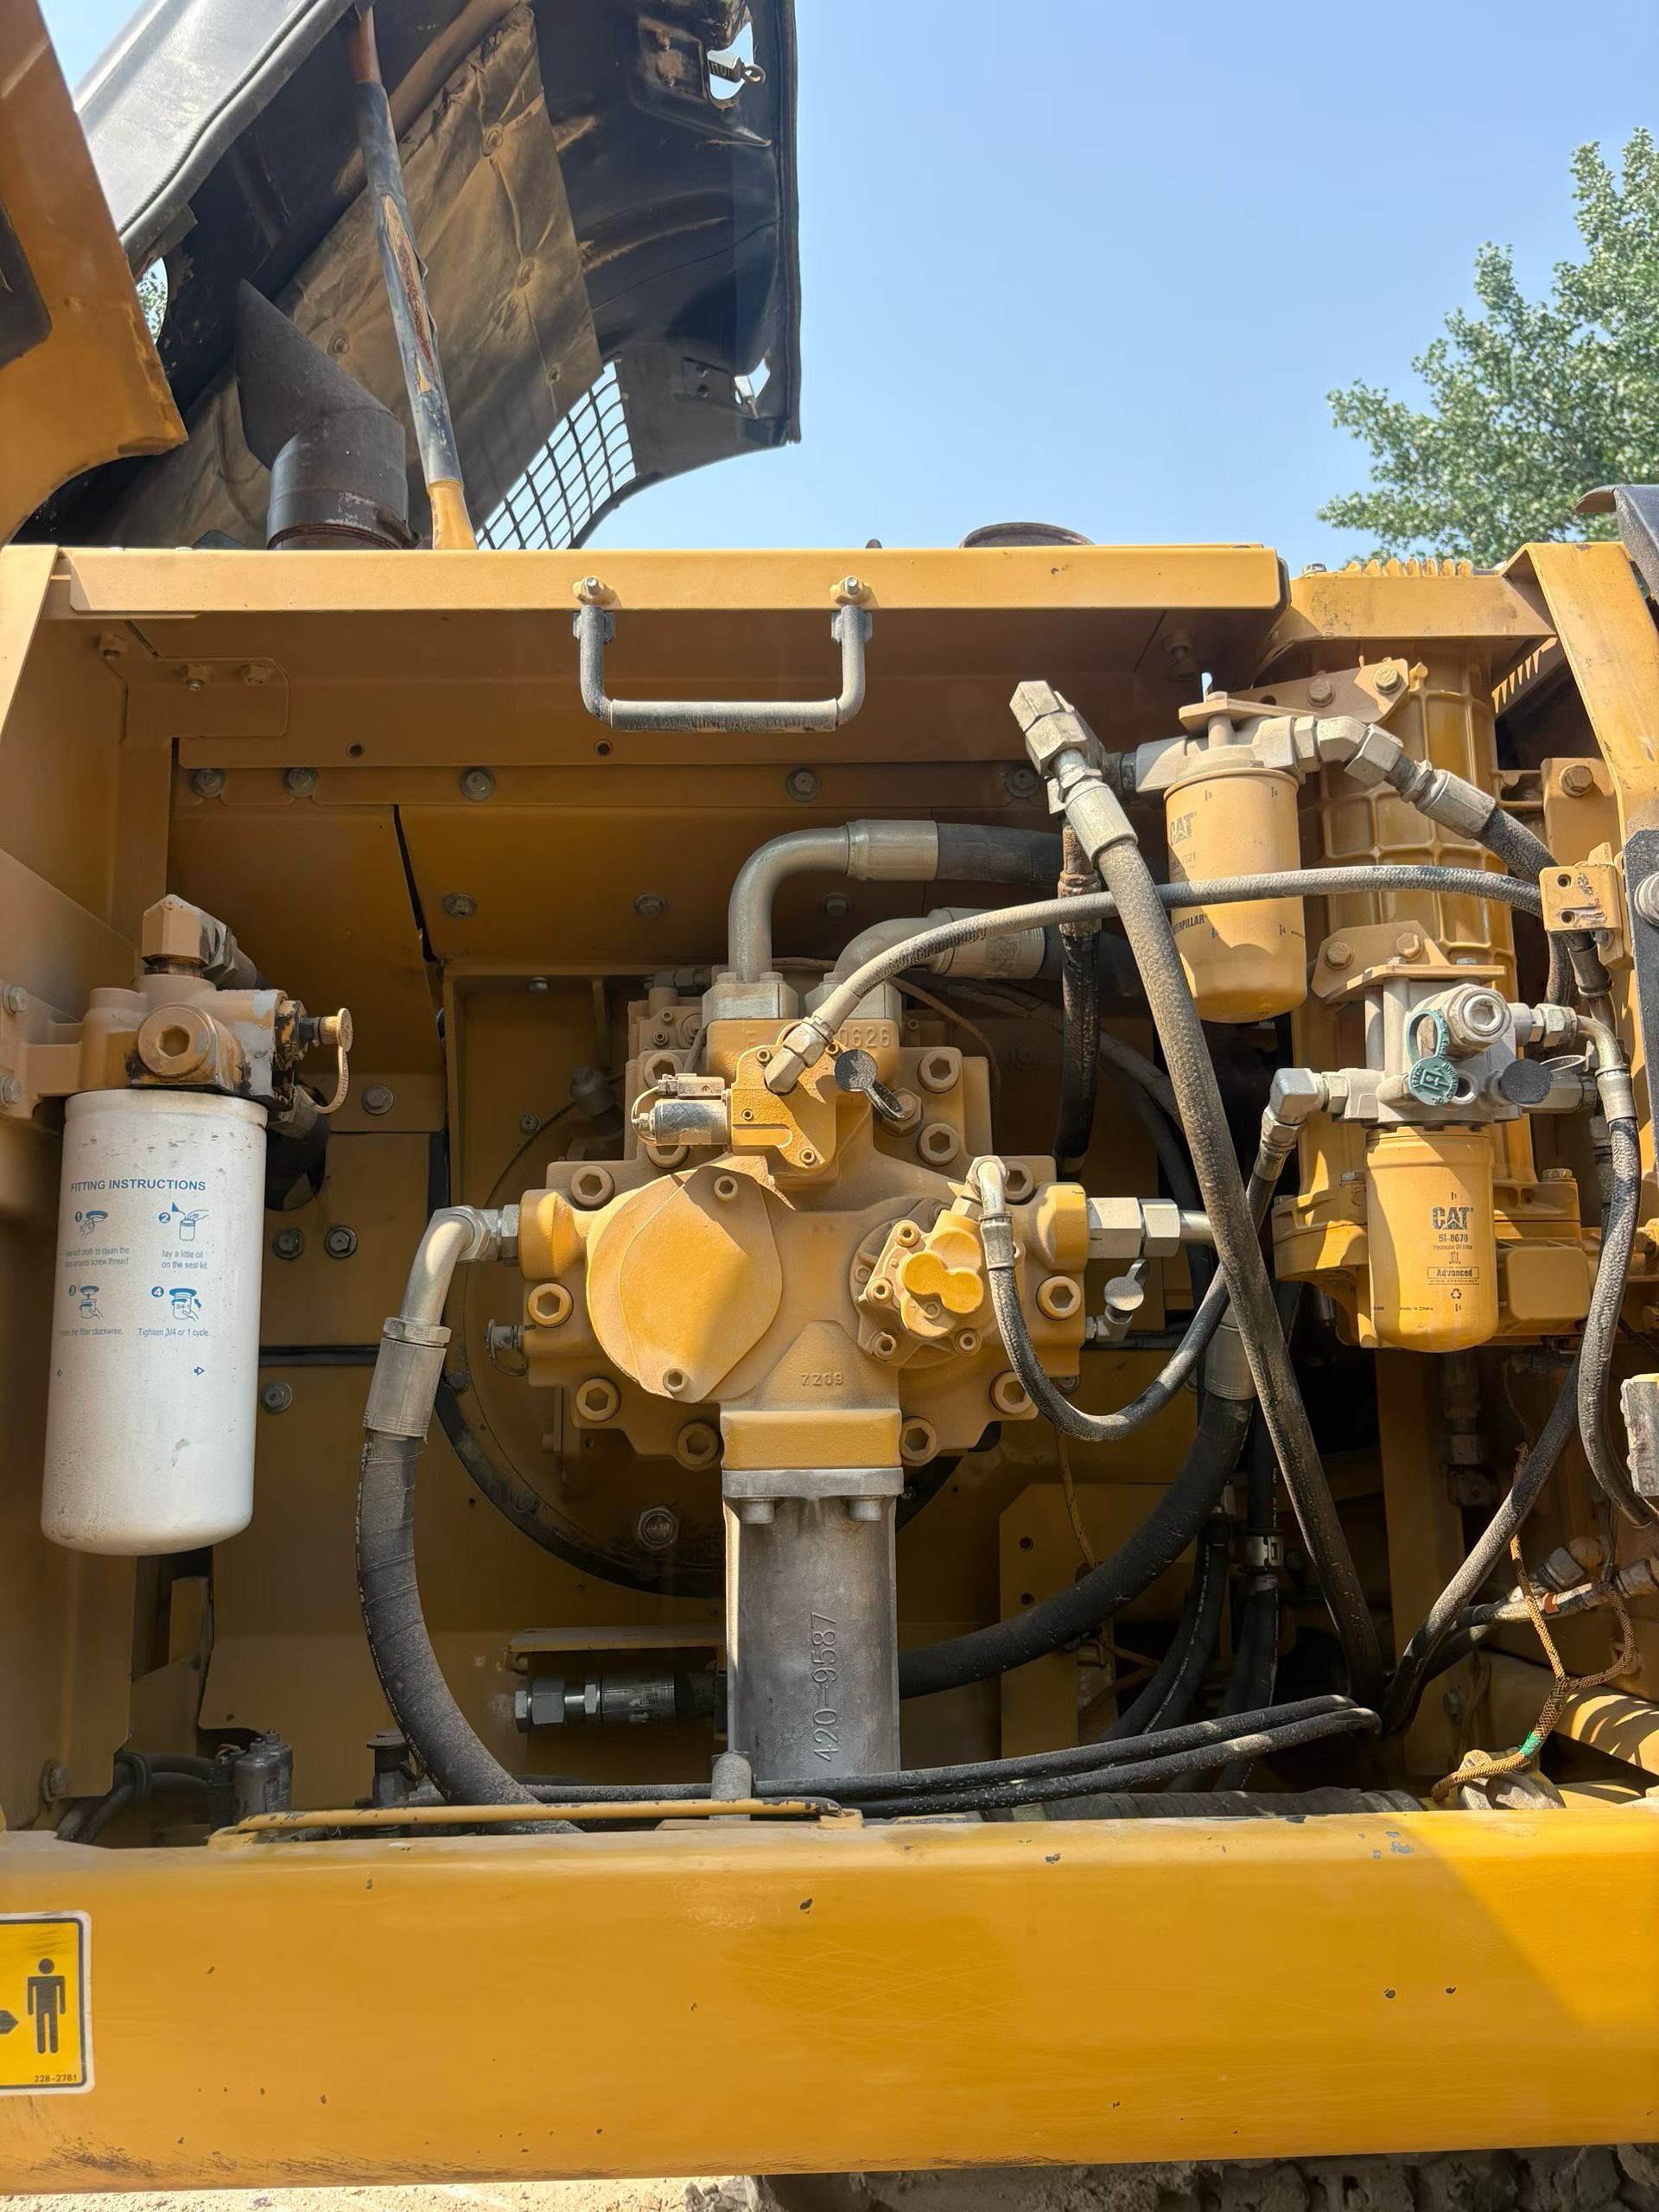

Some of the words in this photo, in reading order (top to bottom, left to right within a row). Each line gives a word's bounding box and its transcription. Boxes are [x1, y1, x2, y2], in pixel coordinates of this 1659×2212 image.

[1170, 812, 1193, 846] CAT
[71, 1179, 105, 1192] FITTING
[109, 1179, 207, 1191] INSTRUCTIONS
[1433, 1206, 1470, 1230] CAT
[162, 1249, 173, 1259] lay
[195, 1250, 204, 1259] oil
[138, 1328, 164, 1337] Tighten
[165, 1328, 176, 1337] 3/4
[811, 1612, 839, 1762] 420-9587
